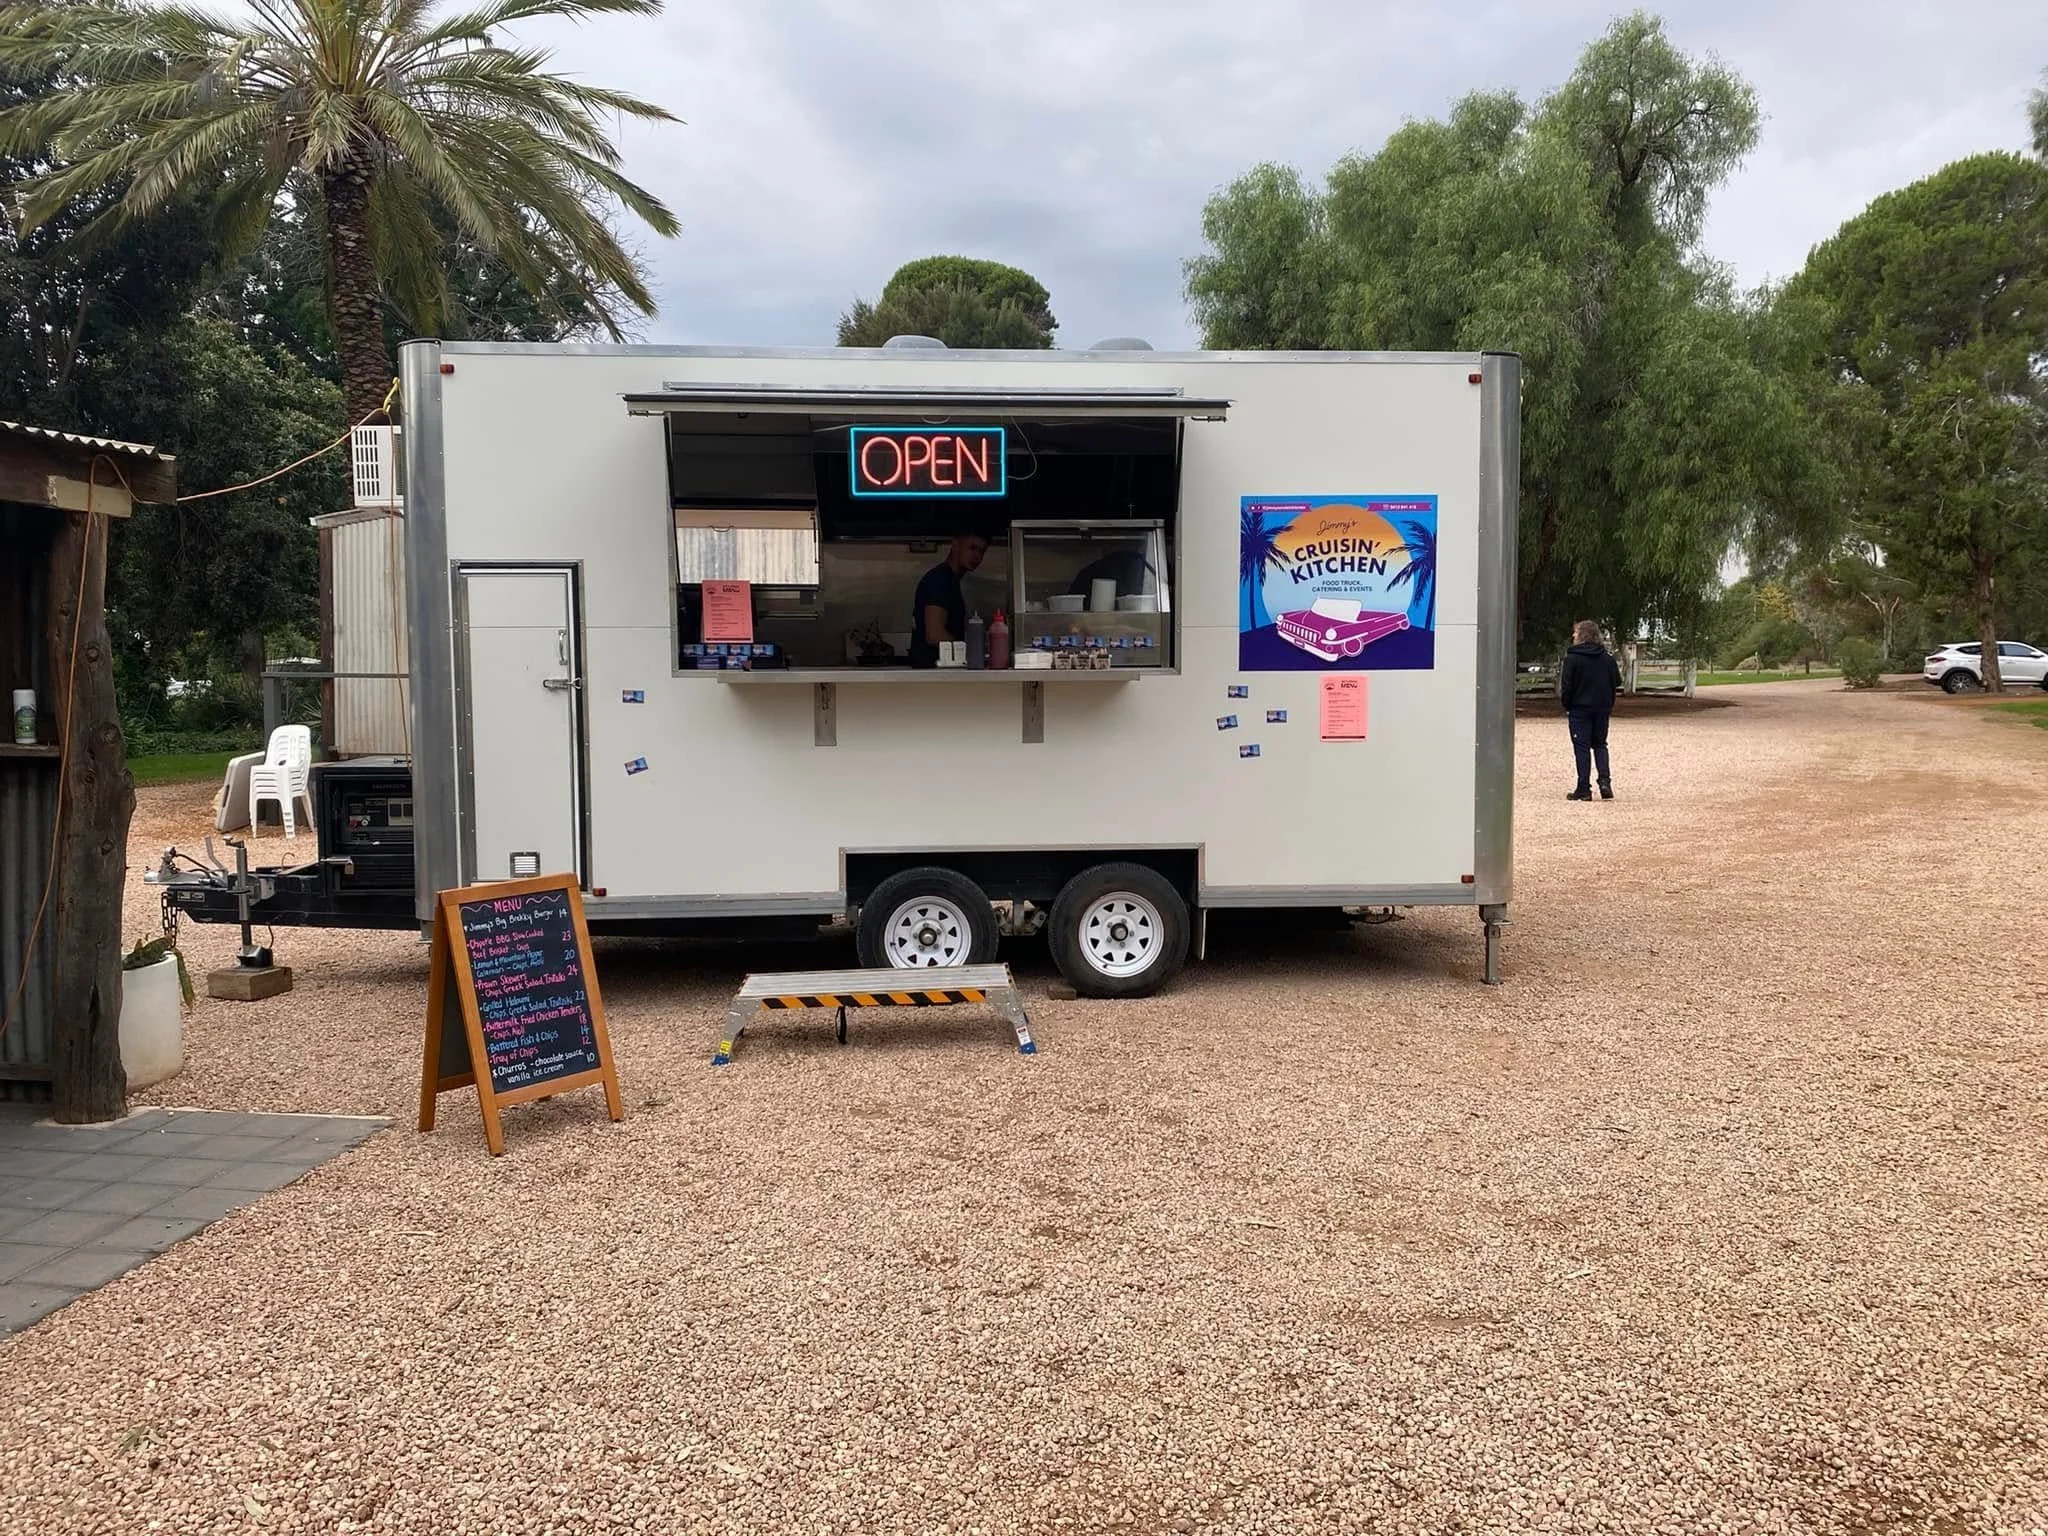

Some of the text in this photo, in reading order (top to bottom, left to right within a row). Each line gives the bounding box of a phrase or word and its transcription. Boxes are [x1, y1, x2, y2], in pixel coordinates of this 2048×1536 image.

[861, 436, 988, 486] OPEN
[1316, 518, 1359, 537] Jimmy's
[1294, 538, 1382, 562] CRUISIN'
[1289, 556, 1388, 585] KITCHEN
[494, 899, 522, 913] MENU
[469, 920, 494, 933] Jimmy's
[495, 917, 507, 929] Big
[509, 913, 533, 925] Brekky
[534, 909, 554, 920] Burger
[562, 930, 571, 941] 23
[474, 959, 494, 970] Lemon
[564, 949, 575, 961] 20
[477, 963, 578, 990] Prawn Skewers 24
[482, 1000, 502, 1012] Grilled
[575, 990, 585, 1001] 22
[503, 984, 524, 994] Greek
[485, 1005, 587, 1032] Buttermilk Fried Chicken Tenders 18
[508, 1005, 529, 1016] Greek
[489, 1039, 519, 1053] Battered
[520, 1034, 535, 1047] Fish
[540, 1030, 559, 1043] Chips
[580, 1025, 590, 1035] 14
[491, 1036, 592, 1065] Tray of Chips 12
[498, 1061, 528, 1076] Churros
[586, 1052, 596, 1063] 10
[507, 1063, 564, 1084] vanilla ice cream
